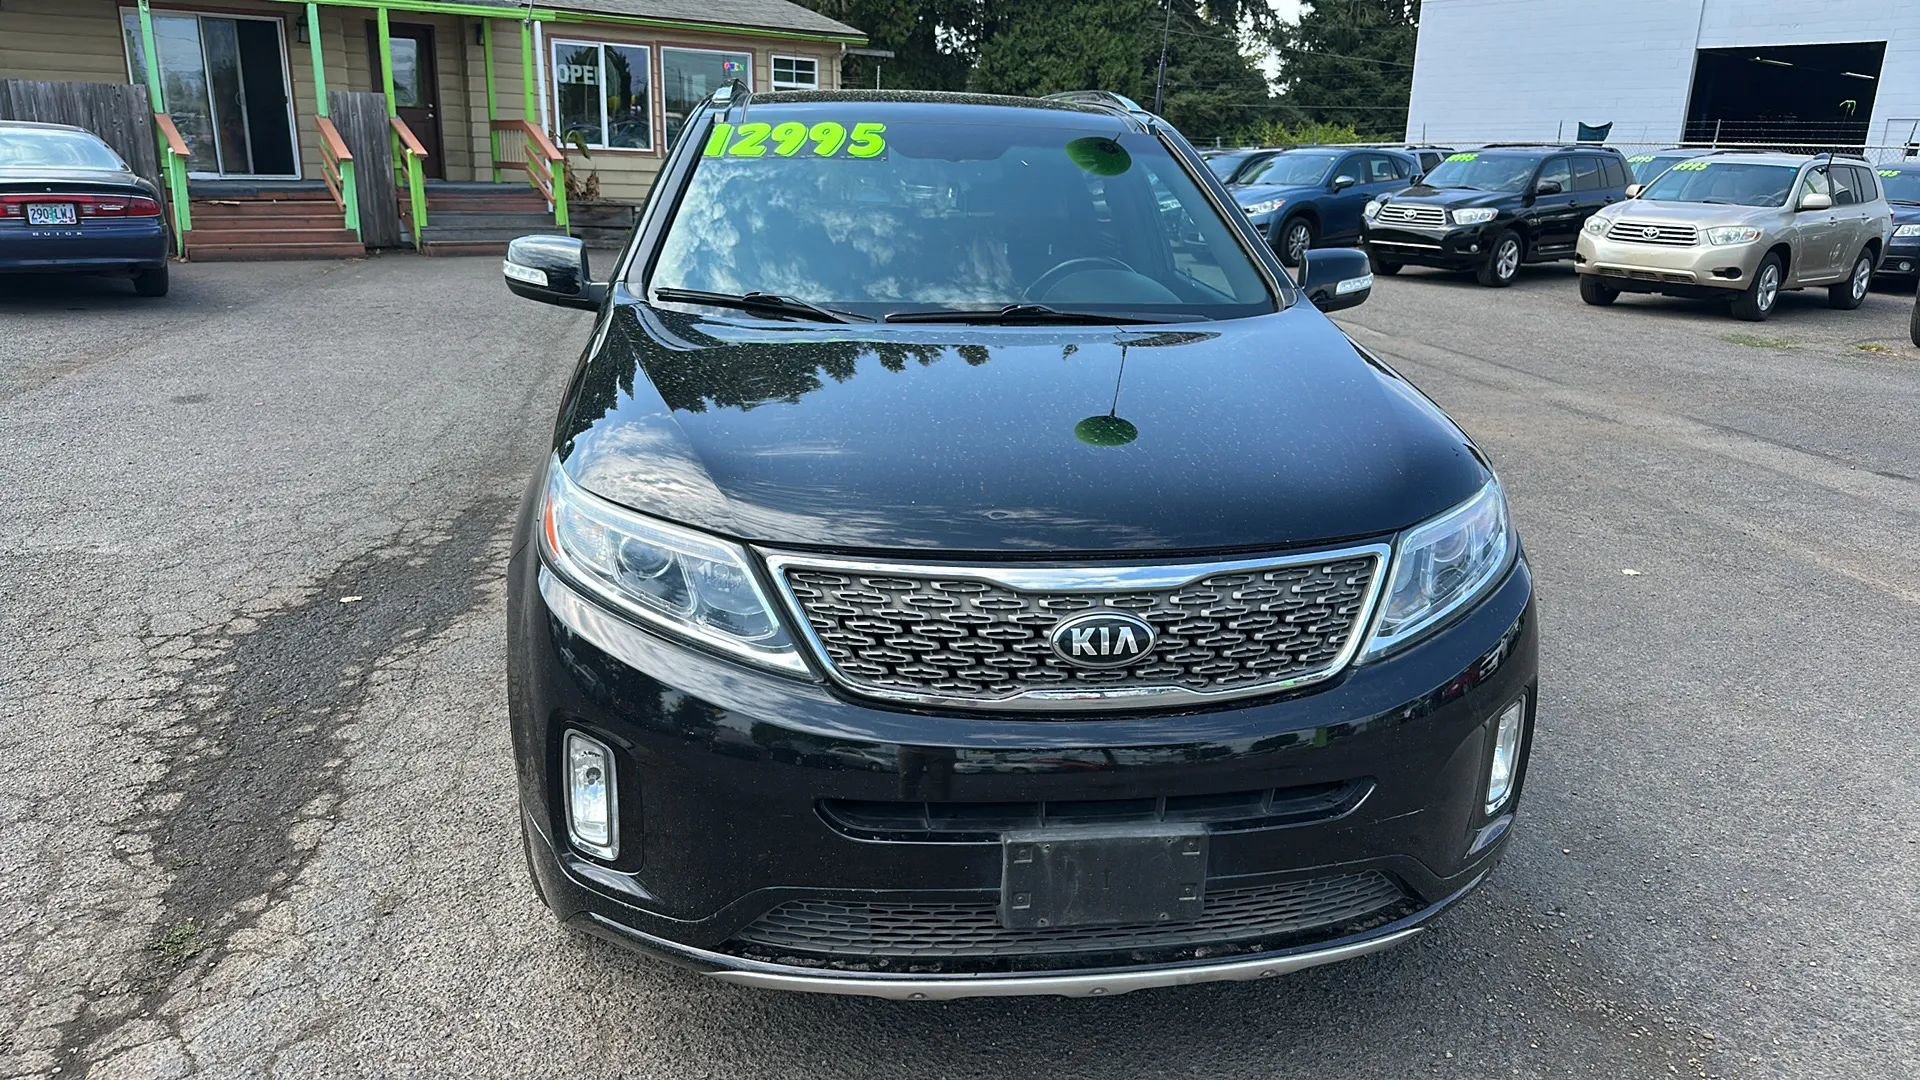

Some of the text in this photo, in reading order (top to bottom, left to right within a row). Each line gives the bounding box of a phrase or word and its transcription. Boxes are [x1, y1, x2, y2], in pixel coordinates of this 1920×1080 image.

[703, 121, 887, 159] 12995
[30, 208, 49, 220] 290
[1070, 626, 1139, 656] KIA
